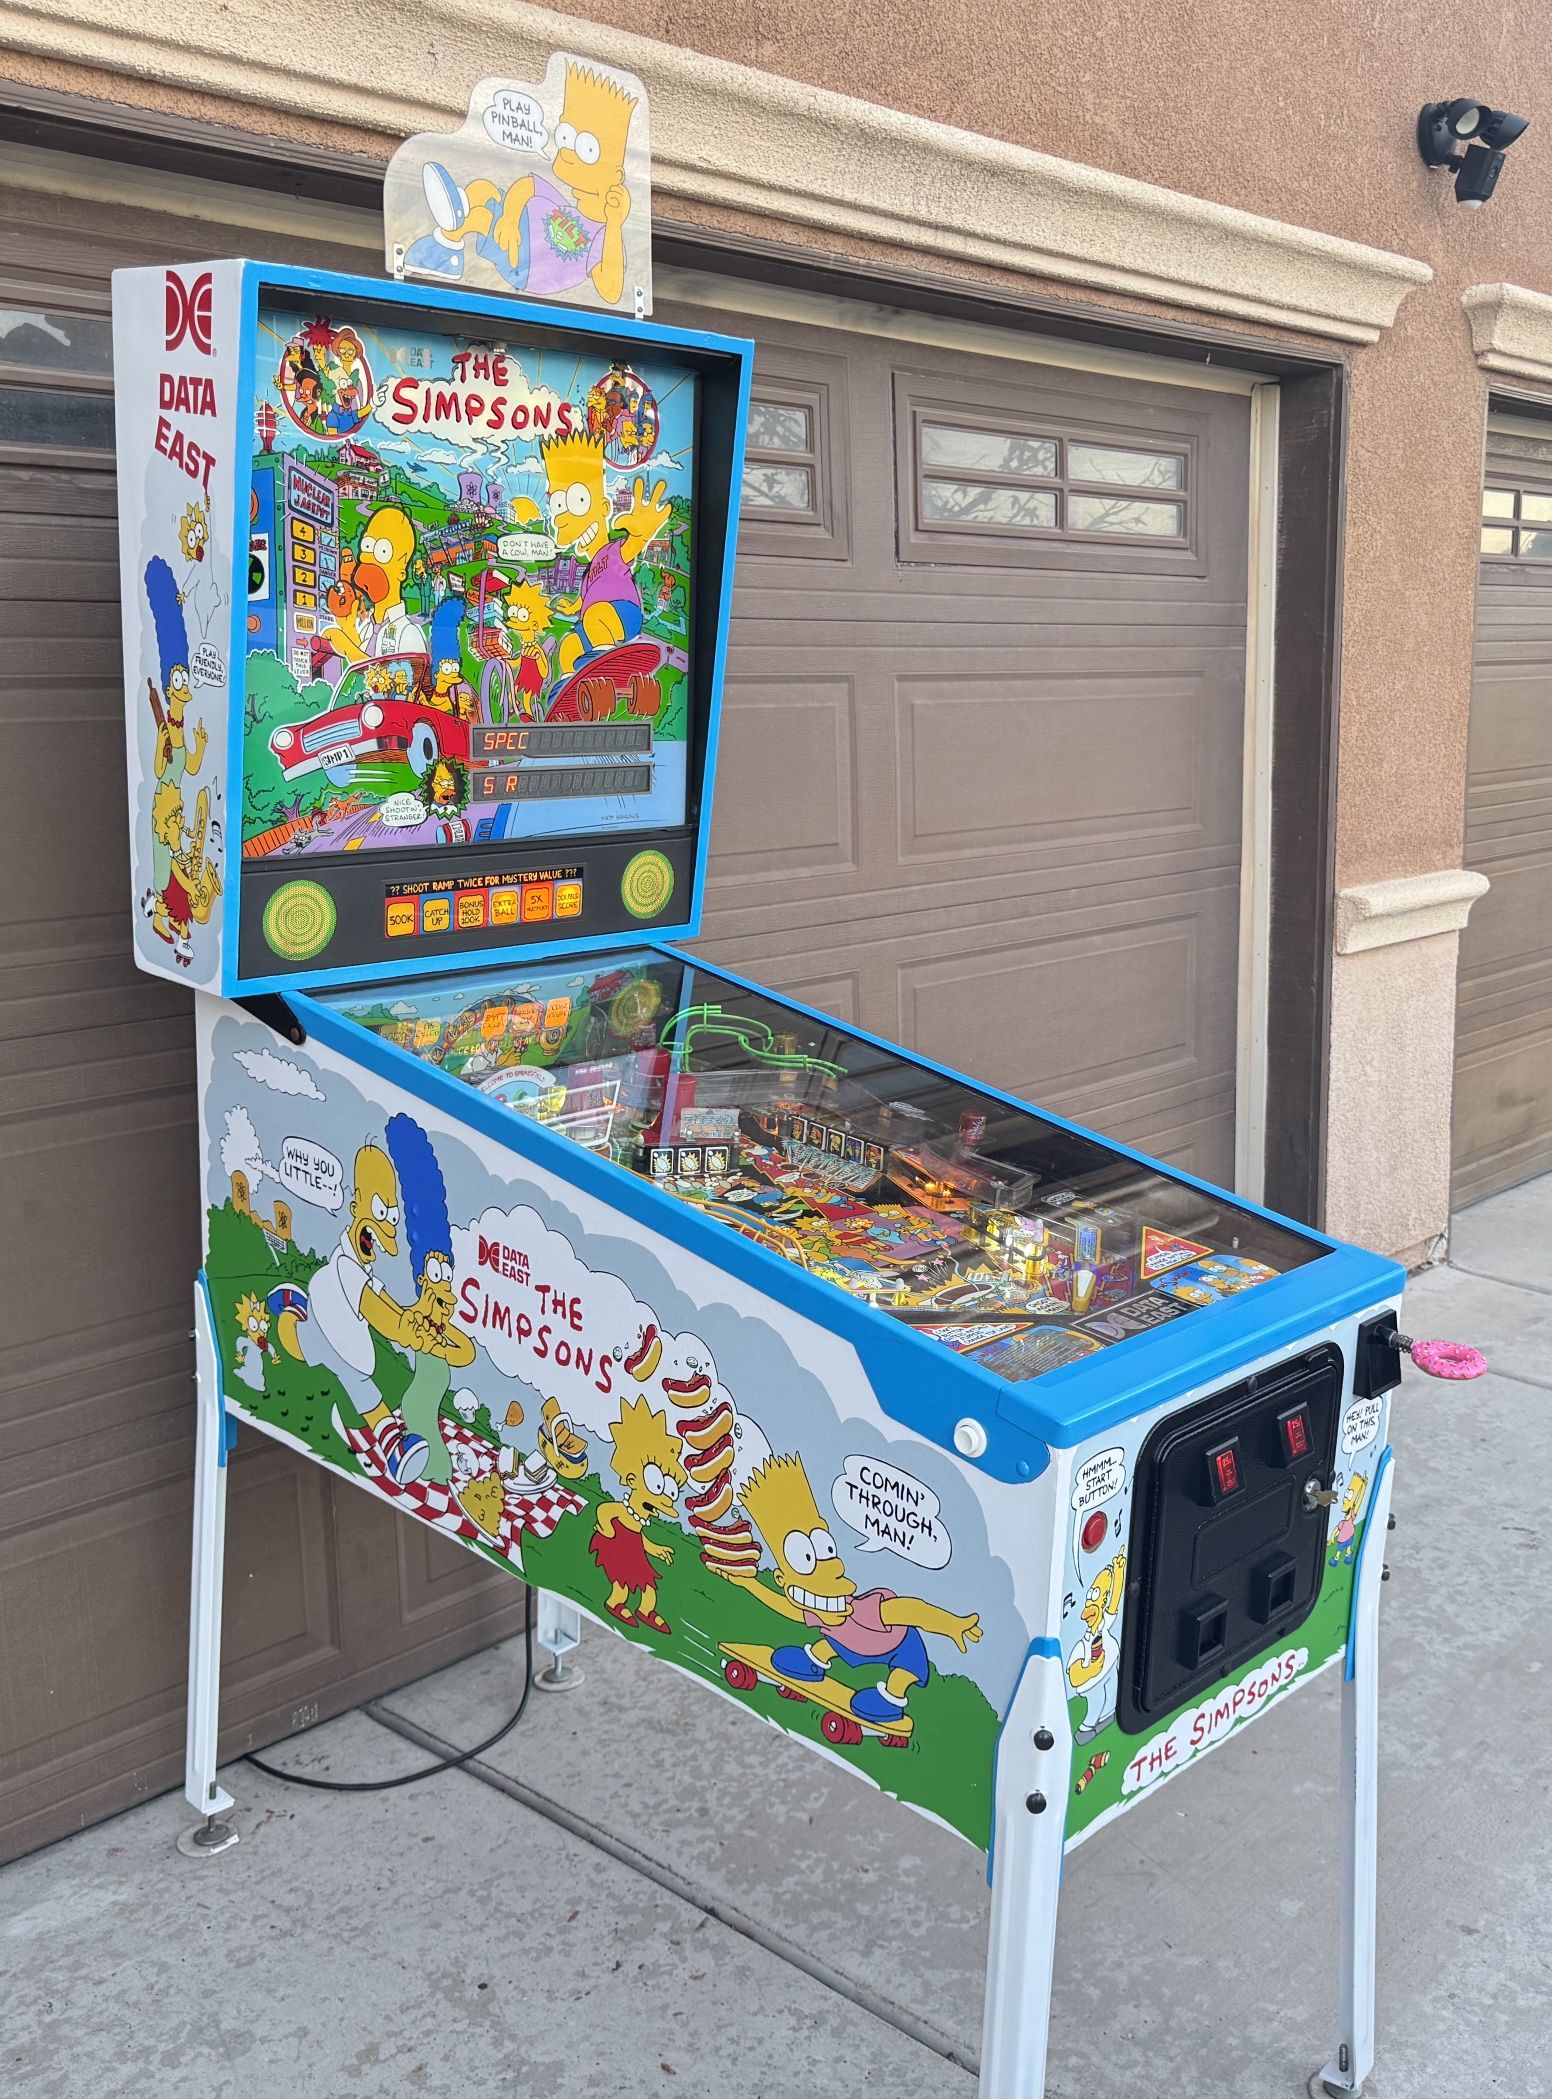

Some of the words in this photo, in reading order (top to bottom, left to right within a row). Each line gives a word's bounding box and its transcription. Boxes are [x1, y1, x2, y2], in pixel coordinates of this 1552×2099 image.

[502, 98, 531, 115] PLAY
[491, 111, 543, 137] PINBALL,
[502, 130, 534, 149] MAN!
[551, 208, 589, 248] TILT
[453, 352, 509, 387] THE
[159, 373, 217, 417] DATA
[391, 377, 572, 436] SIMPSONS
[154, 415, 217, 490] EAST
[293, 473, 331, 508] NUCLEAR
[294, 494, 331, 521] JACKPOT
[299, 526, 307, 537] 4
[502, 539, 528, 548] DON'T
[530, 540, 549, 549] HAVE
[510, 548, 529, 557] COW,
[299, 549, 307, 560] 3
[300, 572, 308, 583] 2
[300, 594, 308, 606] 1
[202, 647, 217, 660] PLAY
[193, 665, 226, 683] EVERYONE!
[483, 731, 530, 751] SPEC
[483, 776, 496, 795] S
[506, 775, 518, 793] R
[394, 798, 413, 806] NICE
[389, 885, 400, 896] ??
[402, 882, 430, 894] SHOOT
[432, 880, 455, 891] RAMP
[456, 877, 484, 889] TWICE
[484, 876, 500, 886] FOR
[502, 871, 538, 884] MYSTERY
[539, 869, 563, 881] VALUE
[565, 868, 578, 878] ???
[459, 900, 484, 910] BONUS
[492, 899, 516, 909] EXTRA
[530, 894, 543, 905] 5X
[557, 892, 579, 901] DOUBLE
[558, 901, 578, 910] SCORE
[389, 913, 414, 926] 500K
[424, 907, 449, 918] CATCH
[431, 916, 443, 926] UP
[461, 916, 481, 925] 100K
[462, 908, 481, 917] HOLD
[495, 908, 515, 917] BALL
[505, 1070, 514, 1079] TO
[285, 1146, 310, 1166] WHY
[312, 1156, 335, 1177] YOU
[502, 1245, 530, 1270] DATA
[501, 1264, 531, 1287] EAST
[534, 1284, 583, 1332] THE
[1119, 1296, 1169, 1317] DATA
[1139, 1302, 1189, 1325] EAST
[458, 1277, 613, 1394] SIMPSONS
[1364, 1402, 1379, 1416] PULL
[1346, 1422, 1358, 1435] ON
[1350, 1429, 1370, 1445] MAN!
[859, 1466, 926, 1507] COMIN'
[1085, 1468, 1113, 1491] START
[1078, 1477, 1119, 1507] BUTTON!
[845, 1481, 939, 1543] THROUGH,
[864, 1514, 915, 1551] MAN!
[1189, 1653, 1297, 1747] SIMPSONS
[1129, 1736, 1178, 1782] THE
